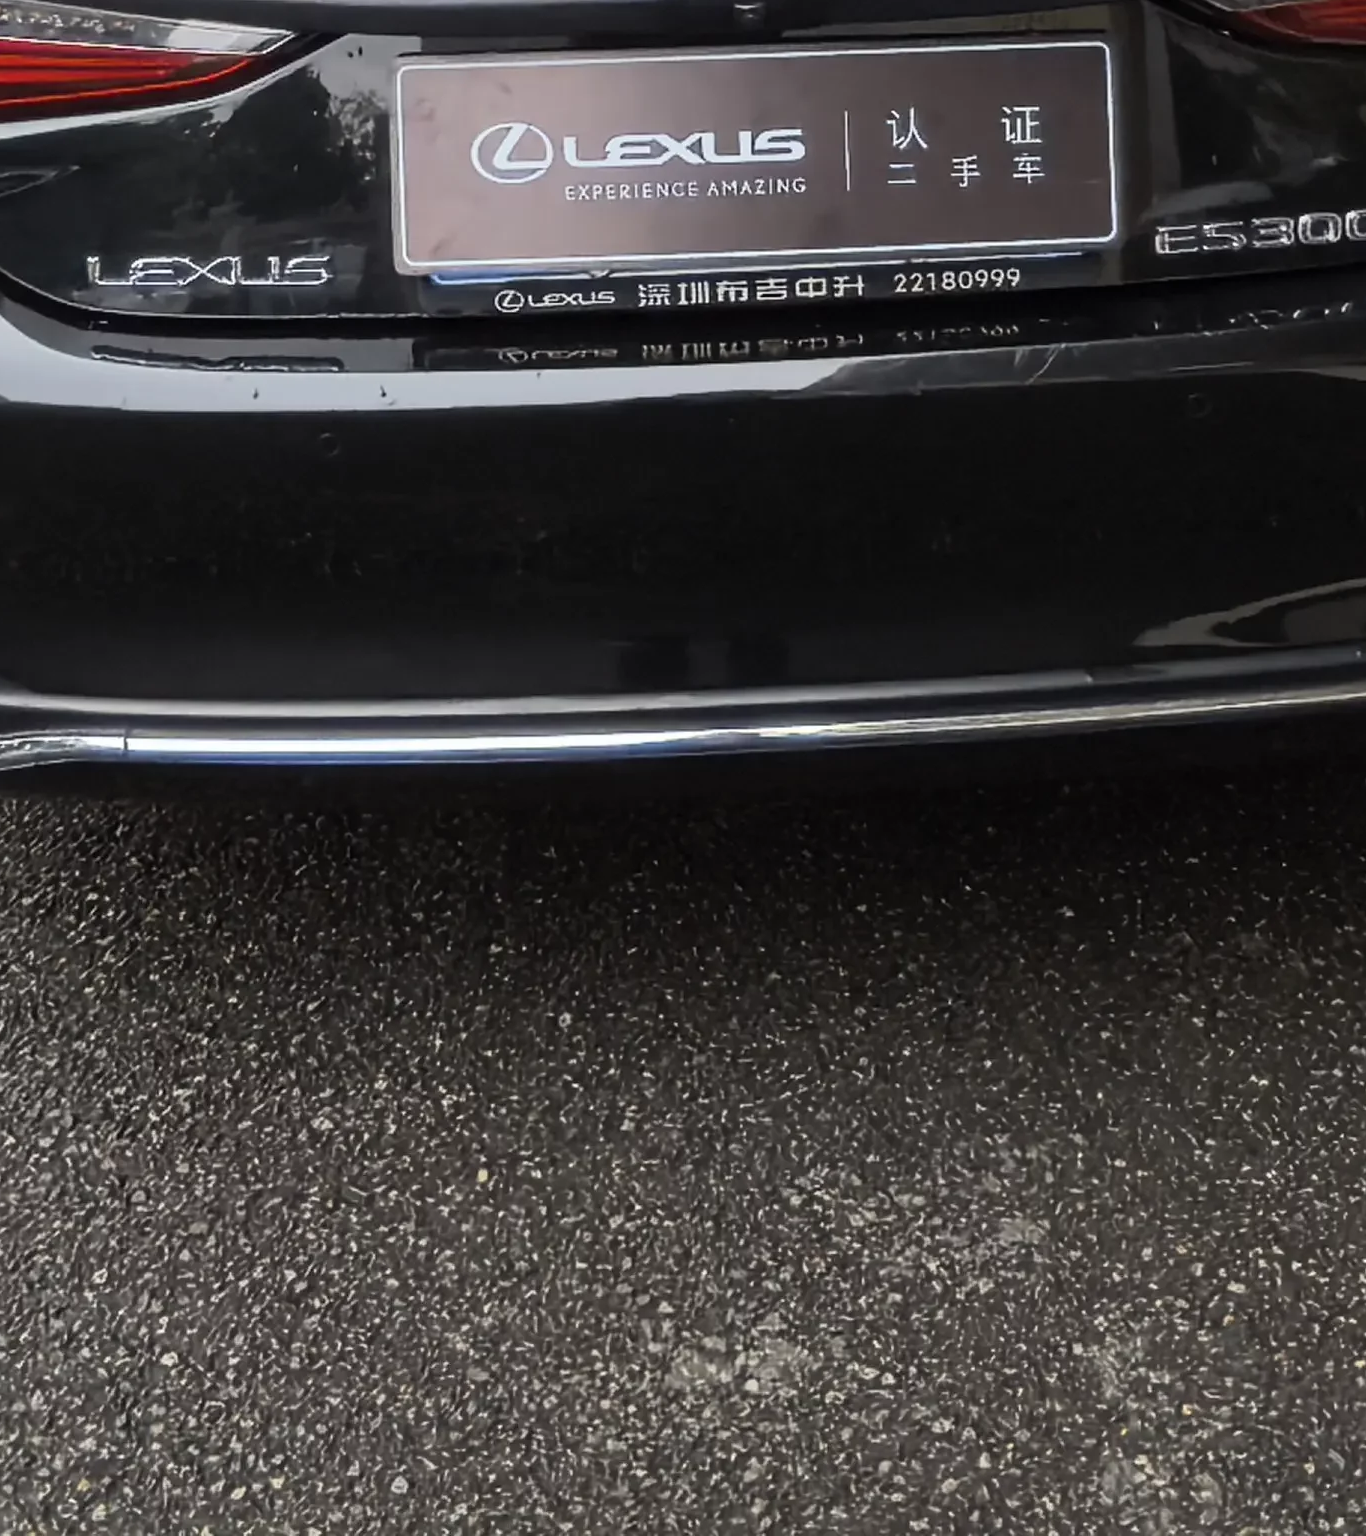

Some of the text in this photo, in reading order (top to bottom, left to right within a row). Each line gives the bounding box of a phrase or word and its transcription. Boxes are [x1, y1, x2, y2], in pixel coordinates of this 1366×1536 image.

[886, 107, 1044, 151] 认证
[562, 128, 806, 170] LEXUS
[887, 154, 1046, 188] 二手车
[564, 178, 807, 202] EXPERIENCE AMAZING
[87, 255, 334, 286] LEXUS
[527, 289, 617, 307] LEXUS
[892, 267, 1022, 296] 22180999
